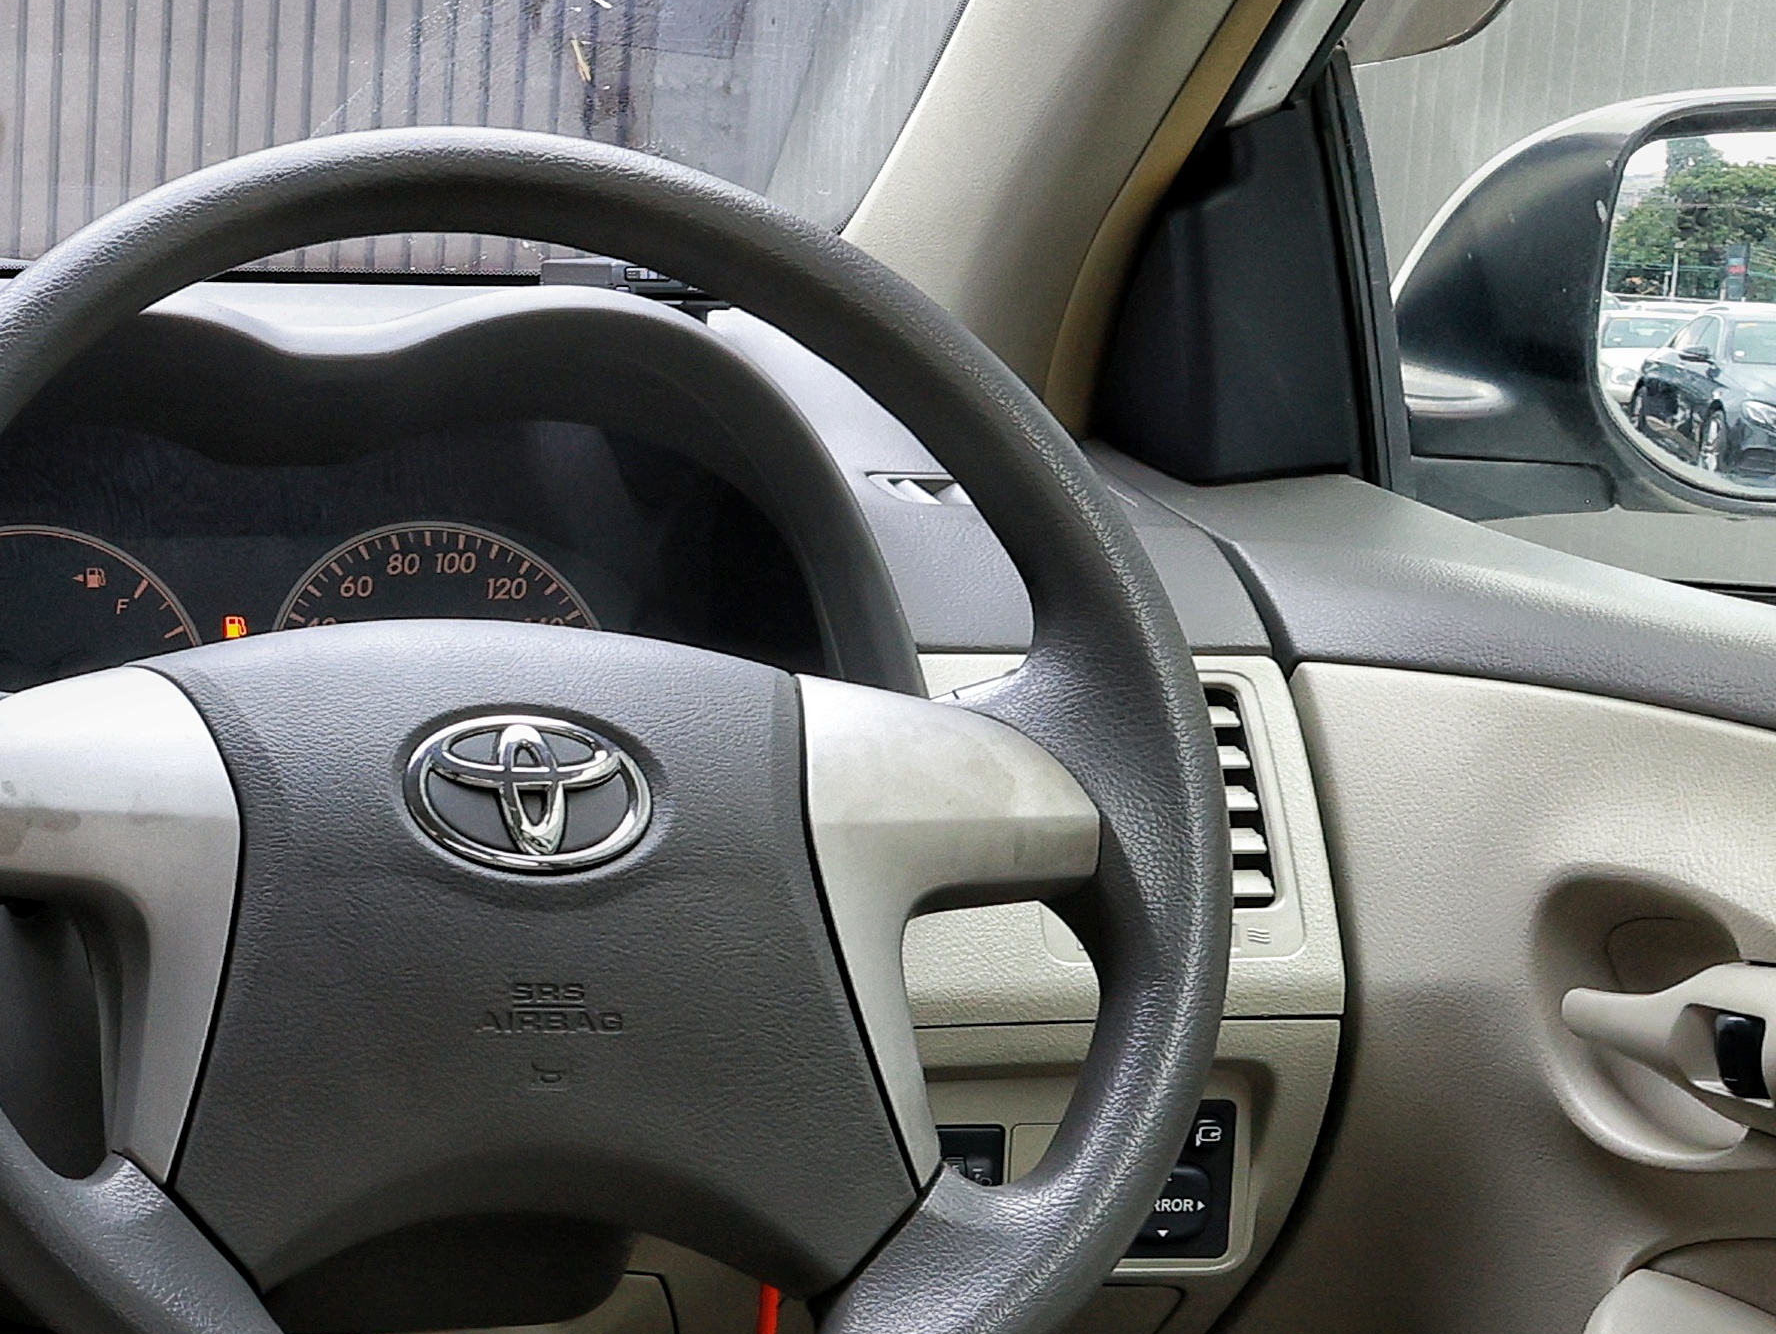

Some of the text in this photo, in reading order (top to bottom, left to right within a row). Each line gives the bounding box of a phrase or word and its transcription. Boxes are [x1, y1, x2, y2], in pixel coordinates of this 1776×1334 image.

[339, 552, 528, 600] 60 80 100 120
[116, 598, 129, 614] F
[511, 982, 585, 1003] SRS
[475, 1011, 624, 1034] AIRBAG
